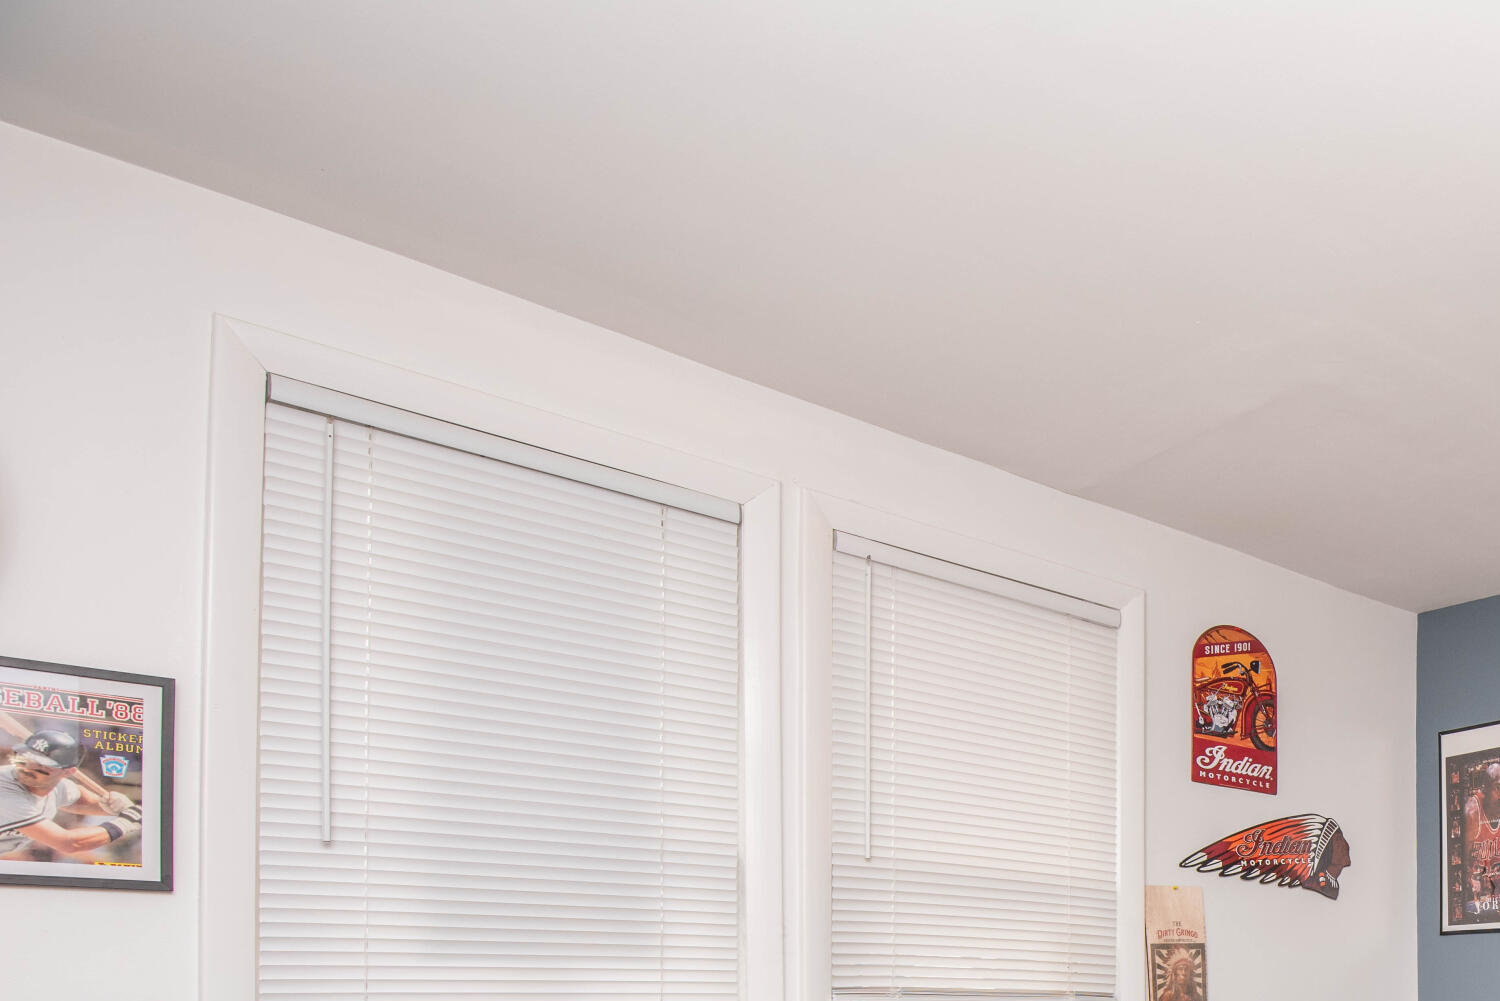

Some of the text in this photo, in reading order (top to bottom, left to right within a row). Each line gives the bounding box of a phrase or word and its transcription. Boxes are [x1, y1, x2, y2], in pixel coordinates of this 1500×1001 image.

[1204, 642, 1251, 655] SINCE 1901
[0, 688, 107, 720] EBALL
[1196, 745, 1274, 781] Indian
[1199, 770, 1271, 789] MOTORCYCLE
[1235, 828, 1313, 858] Indian
[1240, 858, 1311, 867] MOTORCYCLE
